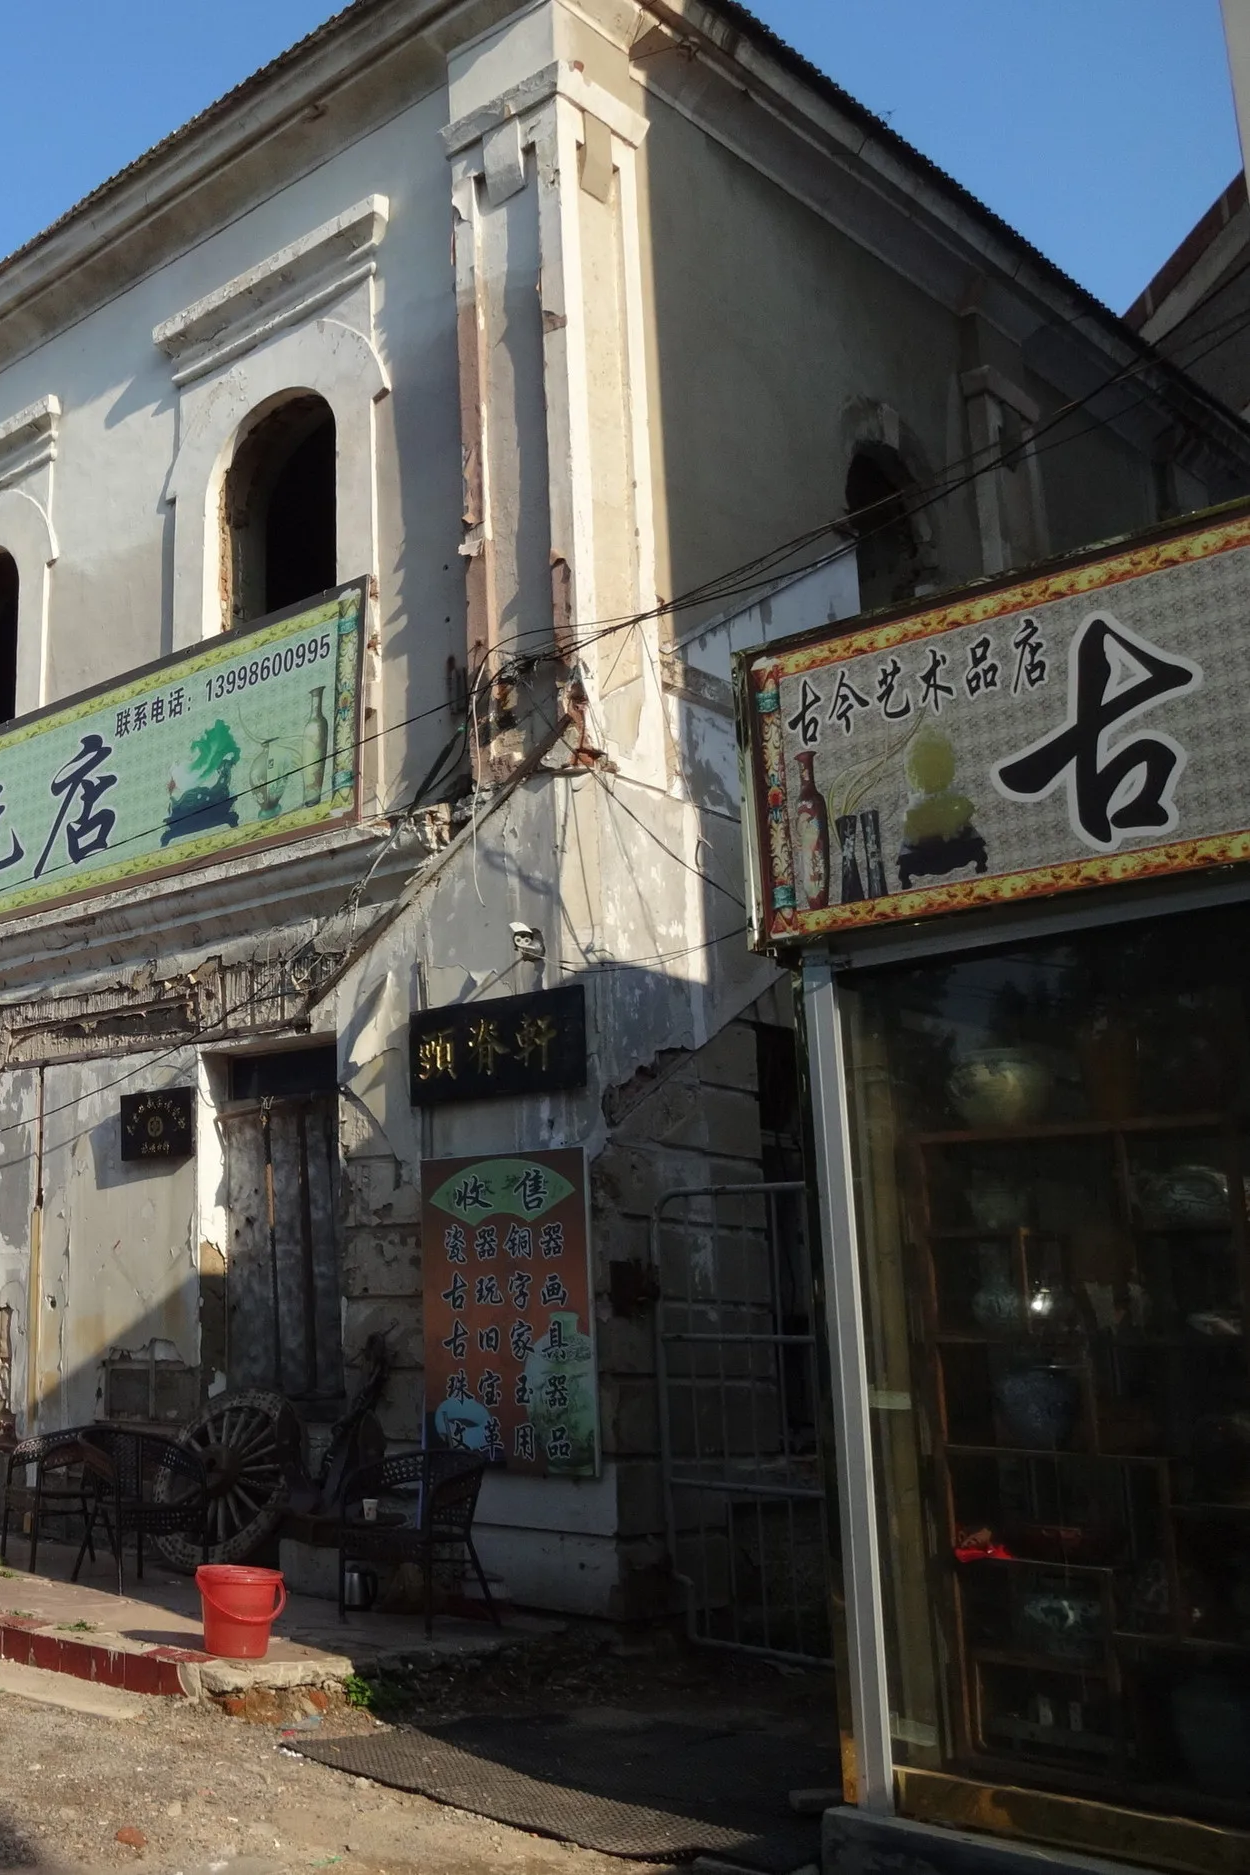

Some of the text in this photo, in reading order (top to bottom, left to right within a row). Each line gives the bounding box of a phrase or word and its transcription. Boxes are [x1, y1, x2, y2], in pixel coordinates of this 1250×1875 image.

[787, 618, 1047, 746] 古今艺术品店
[996, 616, 1196, 845] 古
[444, 1221, 565, 1263] 瓷器铜器
[442, 1270, 568, 1311] 古玩字画
[443, 1317, 568, 1361] 古旧家具
[446, 1368, 571, 1408] 珠宝玉器
[450, 1417, 571, 1461] 文革用品
